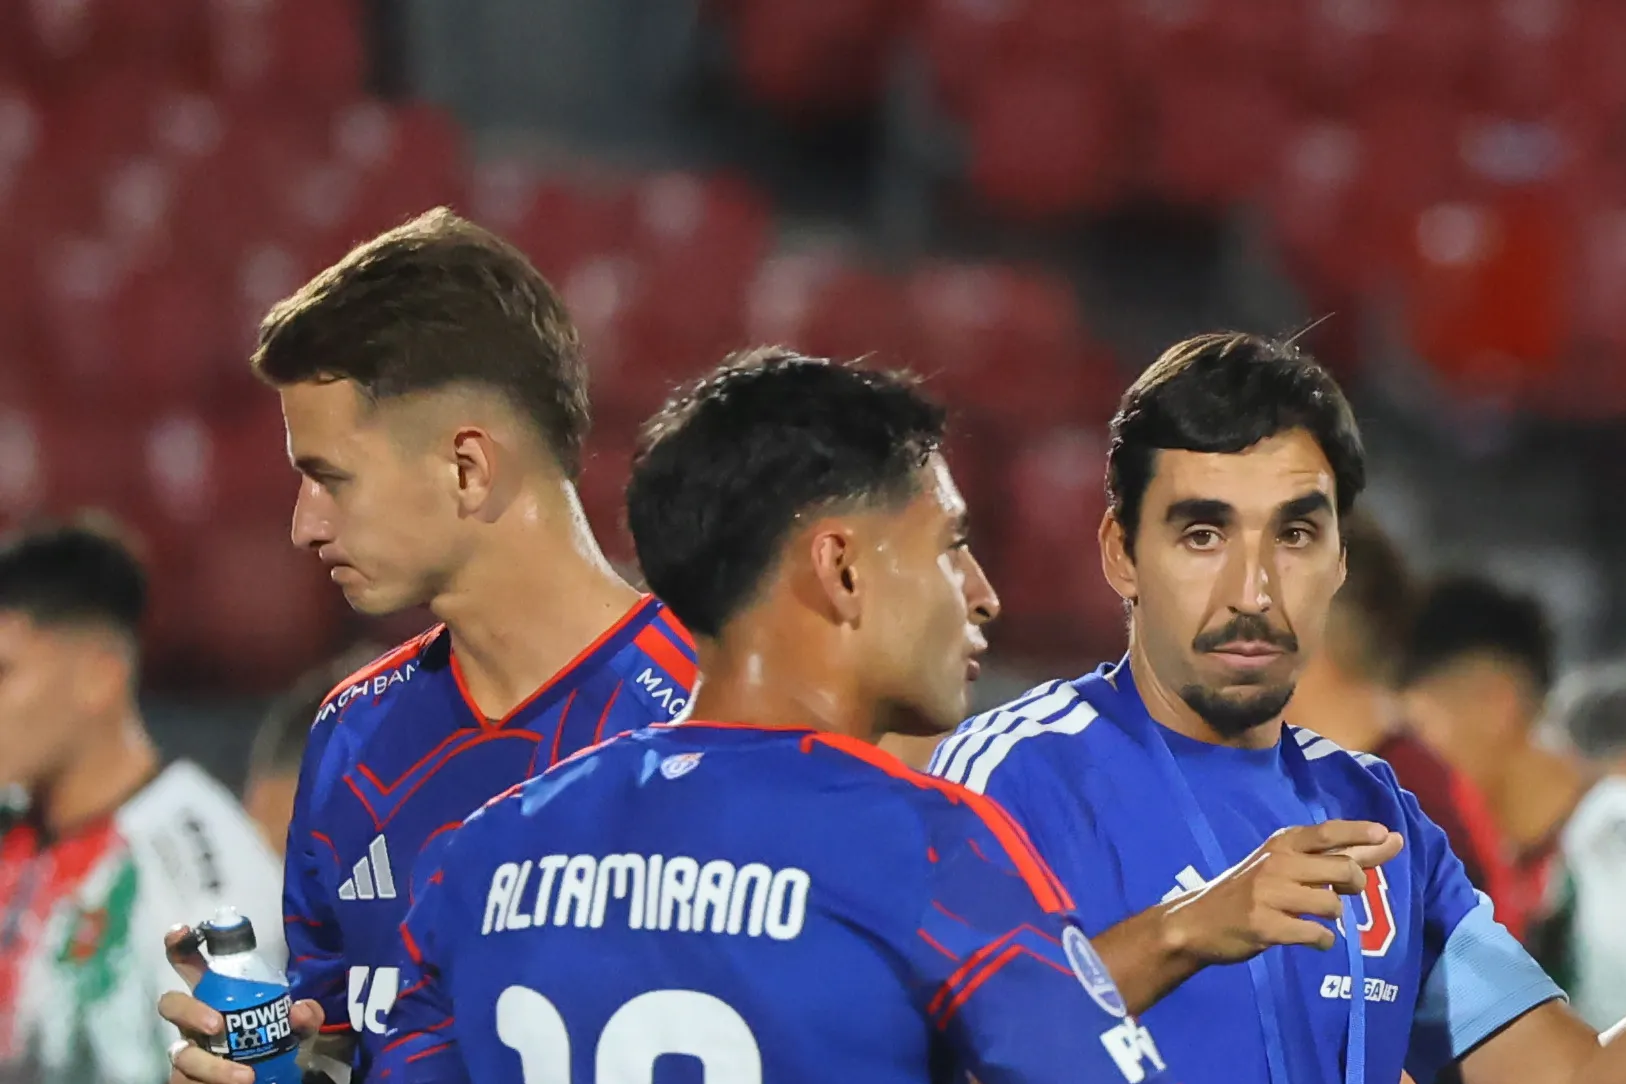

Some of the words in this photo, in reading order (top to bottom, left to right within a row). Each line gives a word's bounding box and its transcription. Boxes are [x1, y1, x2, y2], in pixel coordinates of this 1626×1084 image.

[636, 668, 686, 716] MAC
[482, 853, 810, 940] ALTAMIRANO
[266, 1017, 291, 1042] AD
